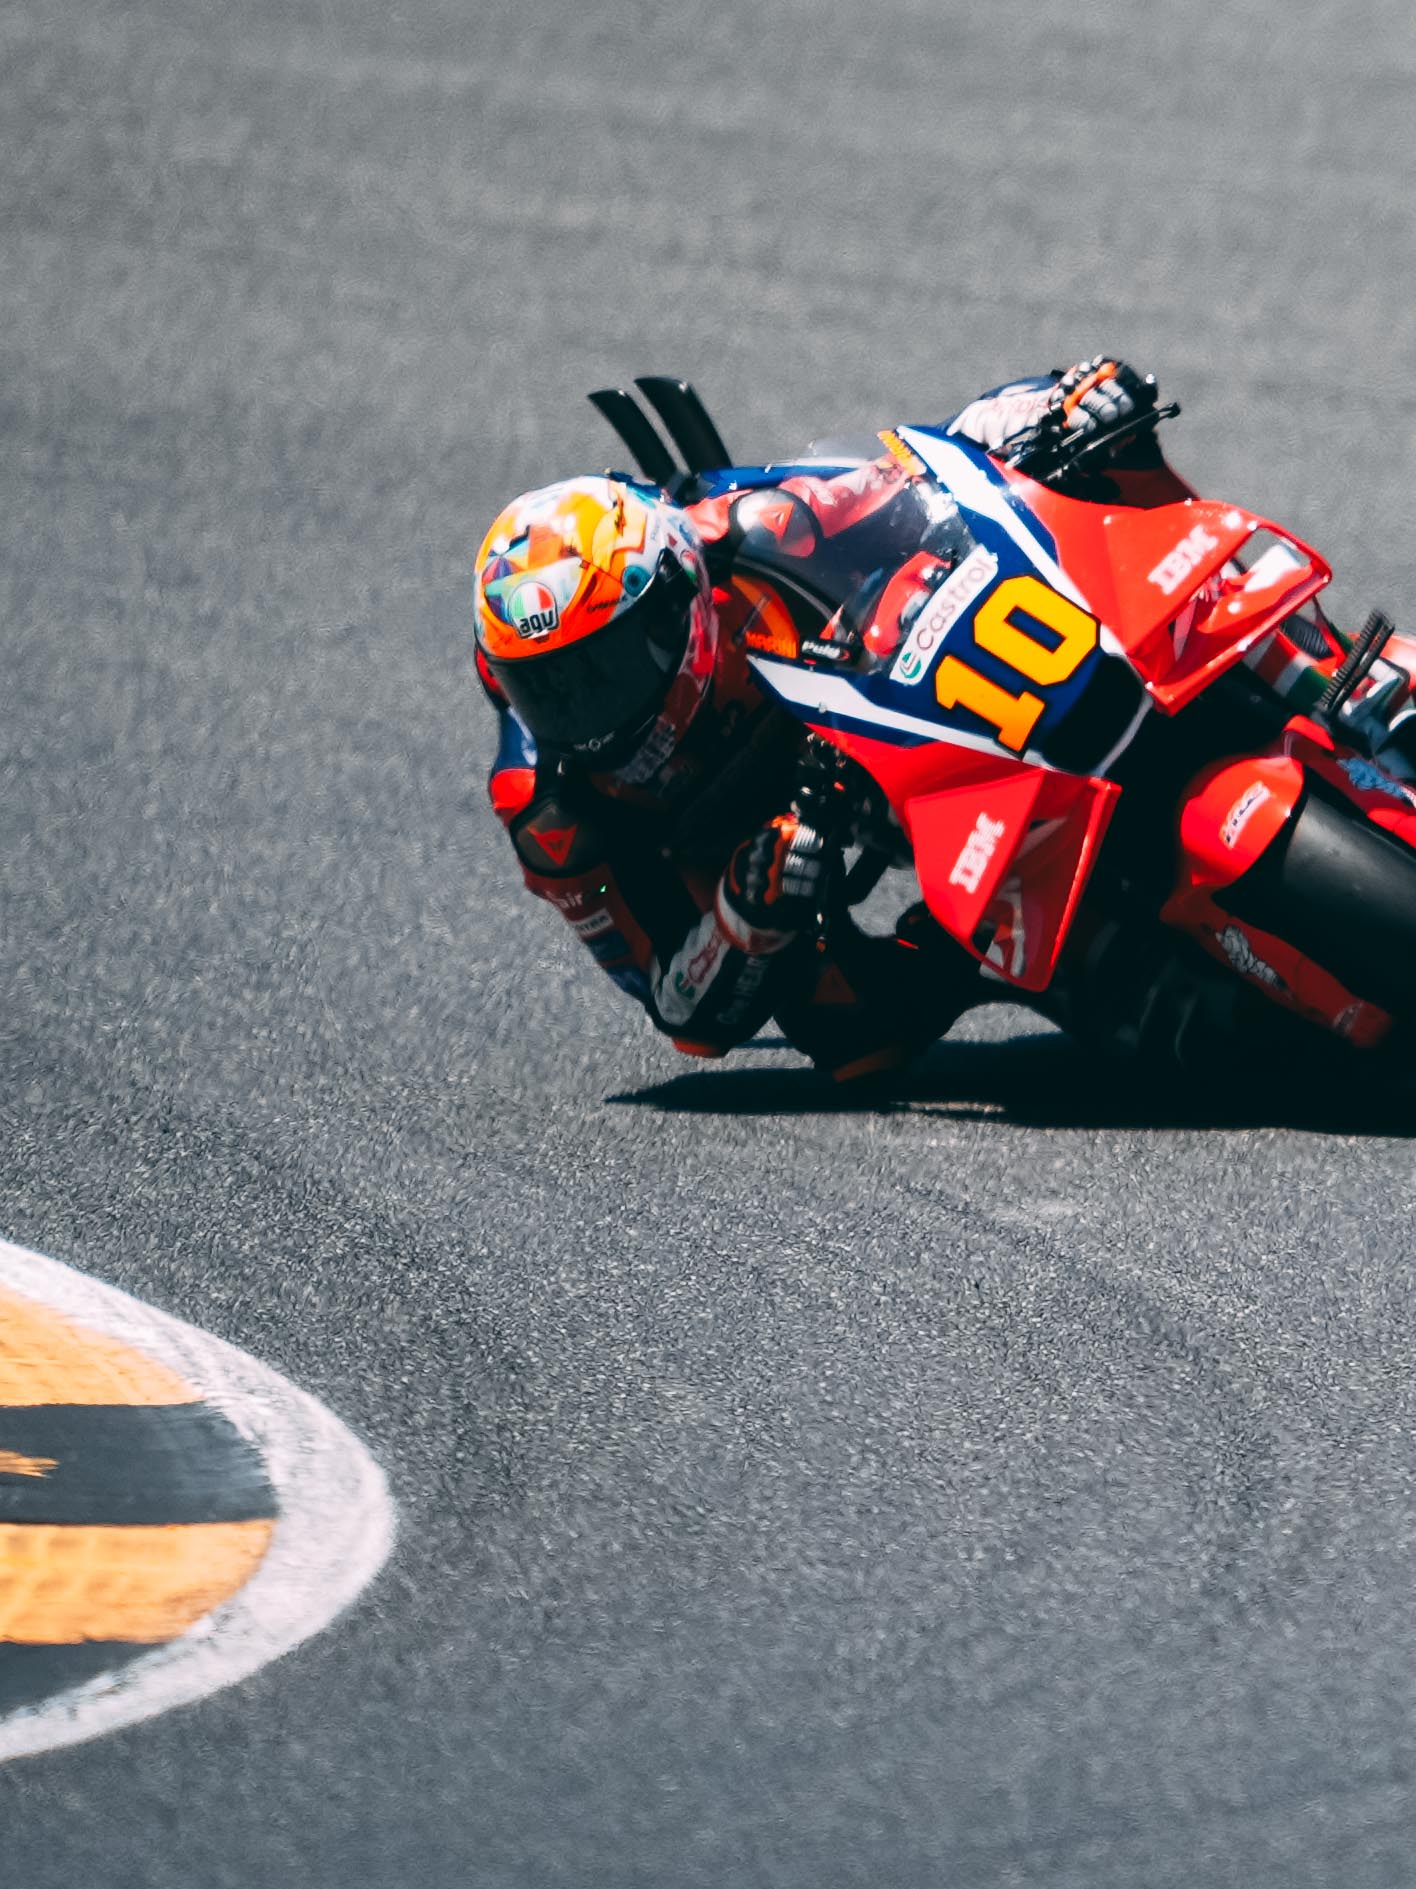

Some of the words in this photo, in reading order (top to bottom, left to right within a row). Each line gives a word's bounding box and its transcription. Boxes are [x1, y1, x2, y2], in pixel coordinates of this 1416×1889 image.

[1147, 524, 1218, 595] IBM
[917, 557, 993, 650] Castrol
[935, 575, 1100, 759] 10
[949, 812, 1004, 894] IBM
